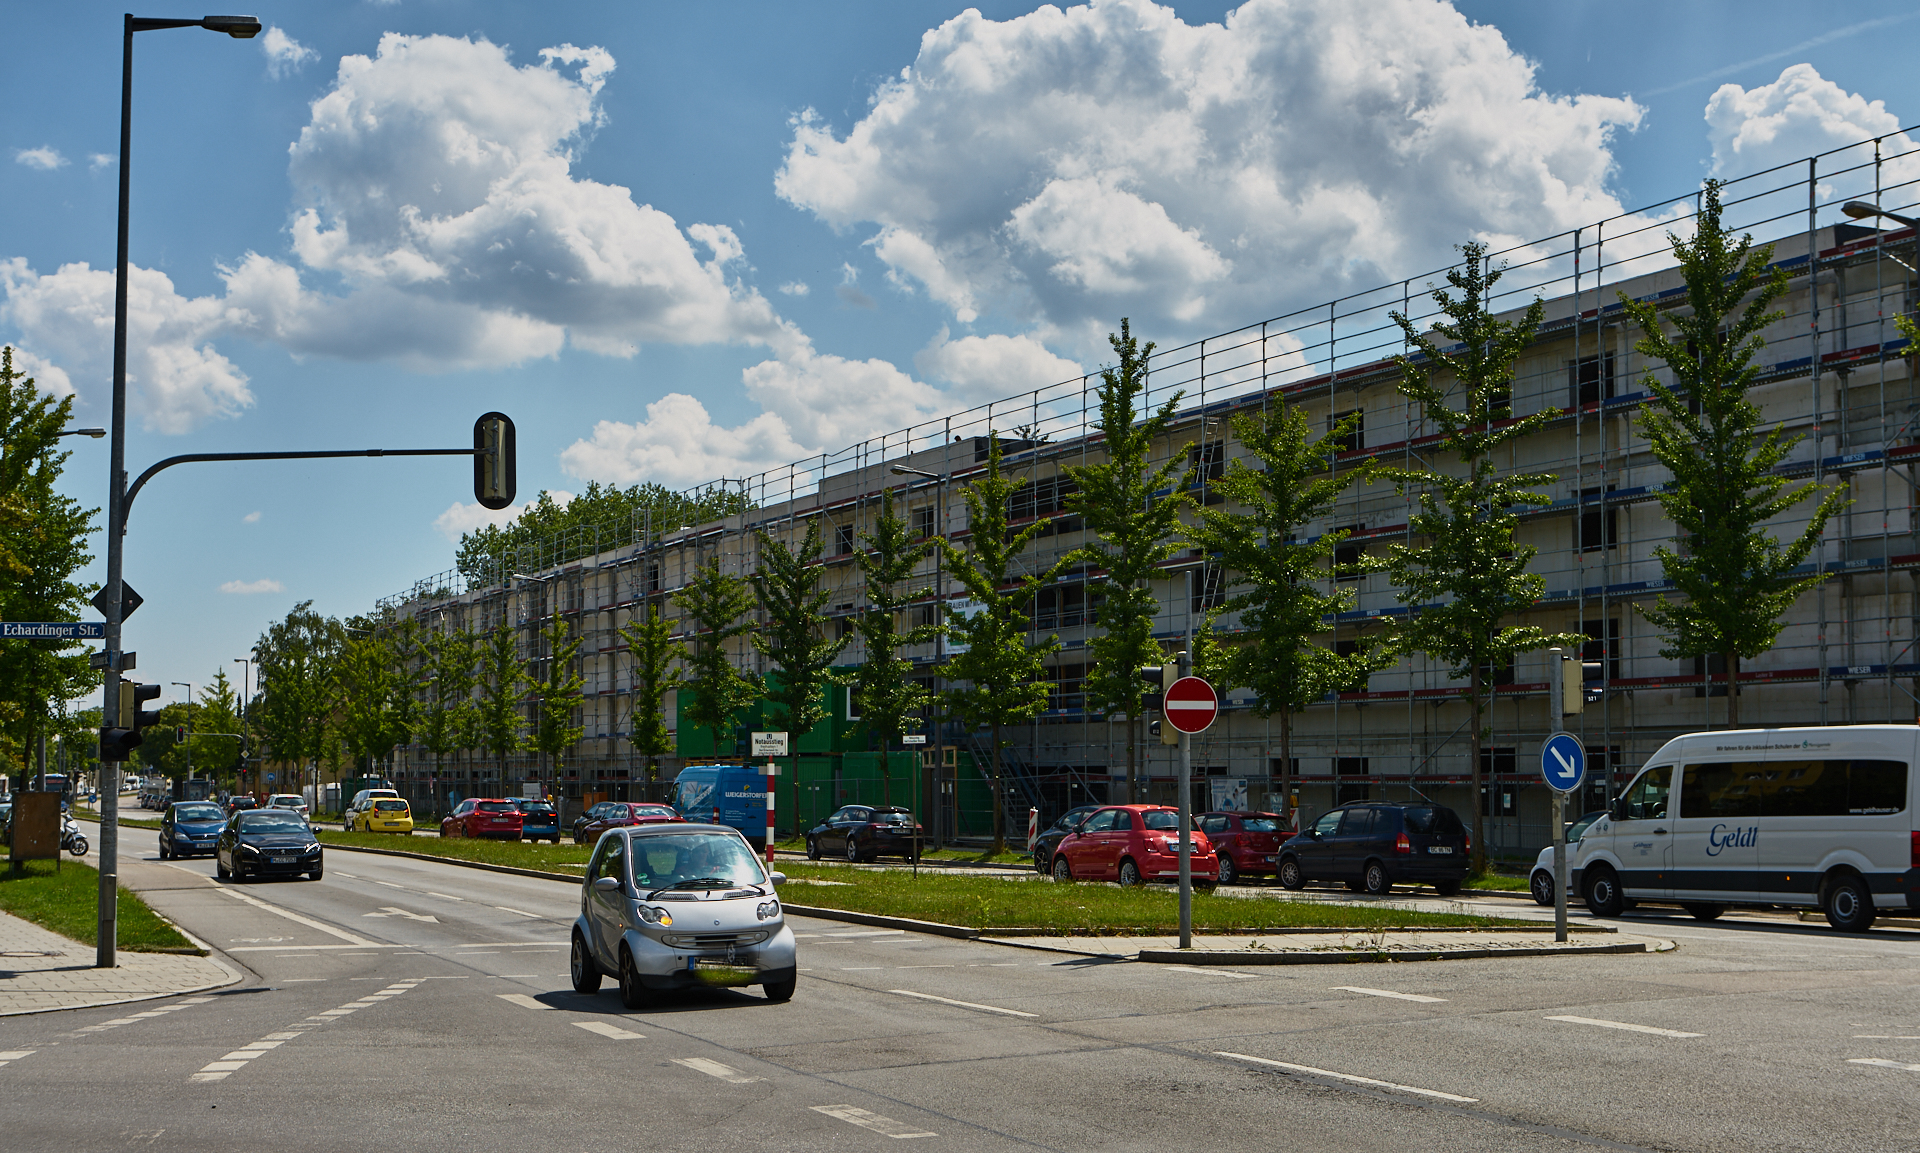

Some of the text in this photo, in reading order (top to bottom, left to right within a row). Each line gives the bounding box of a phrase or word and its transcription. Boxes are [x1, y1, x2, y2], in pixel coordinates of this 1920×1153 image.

[1843, 453, 1865, 462] WIESER
[1645, 484, 1664, 492] WIESER
[1845, 559, 1867, 568] WIESER
[1646, 580, 1664, 588] WIESER
[4, 624, 99, 638] Echardinger Str.
[1848, 665, 1871, 674] WIESER
[754, 738, 784, 747] Notausstieg
